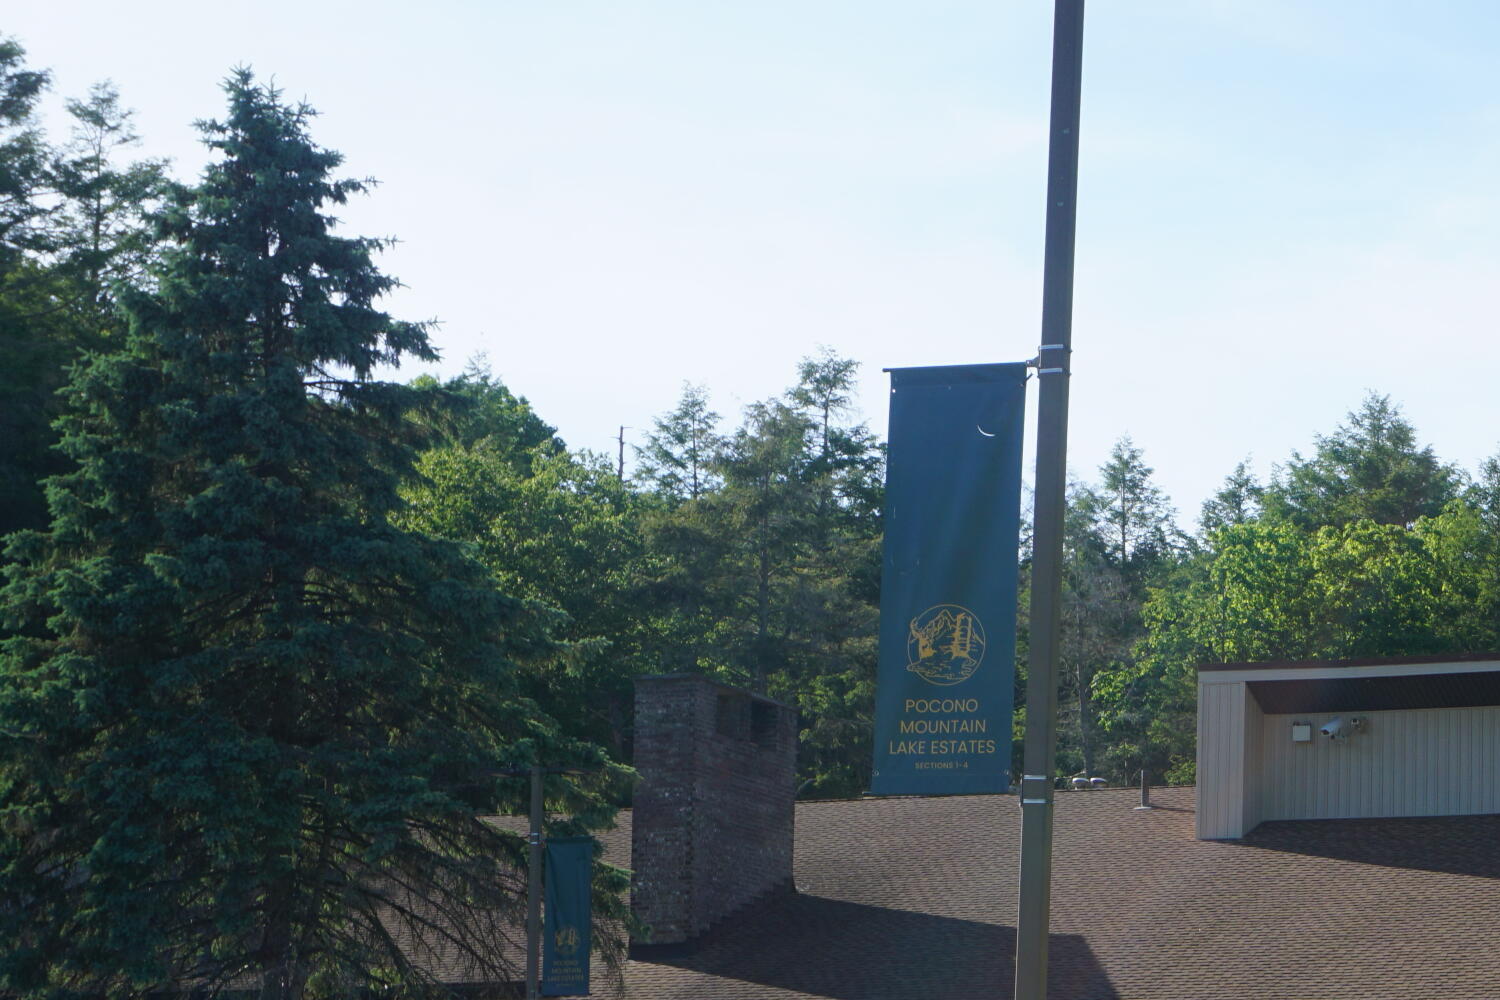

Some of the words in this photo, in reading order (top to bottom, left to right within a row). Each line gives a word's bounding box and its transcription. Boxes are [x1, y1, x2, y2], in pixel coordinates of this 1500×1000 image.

[905, 699, 979, 713] POCONO
[900, 719, 986, 734] MOUNTAIN
[889, 741, 926, 755] LAKE
[931, 739, 996, 754] ESTATES
[914, 761, 953, 769] SECTIONS
